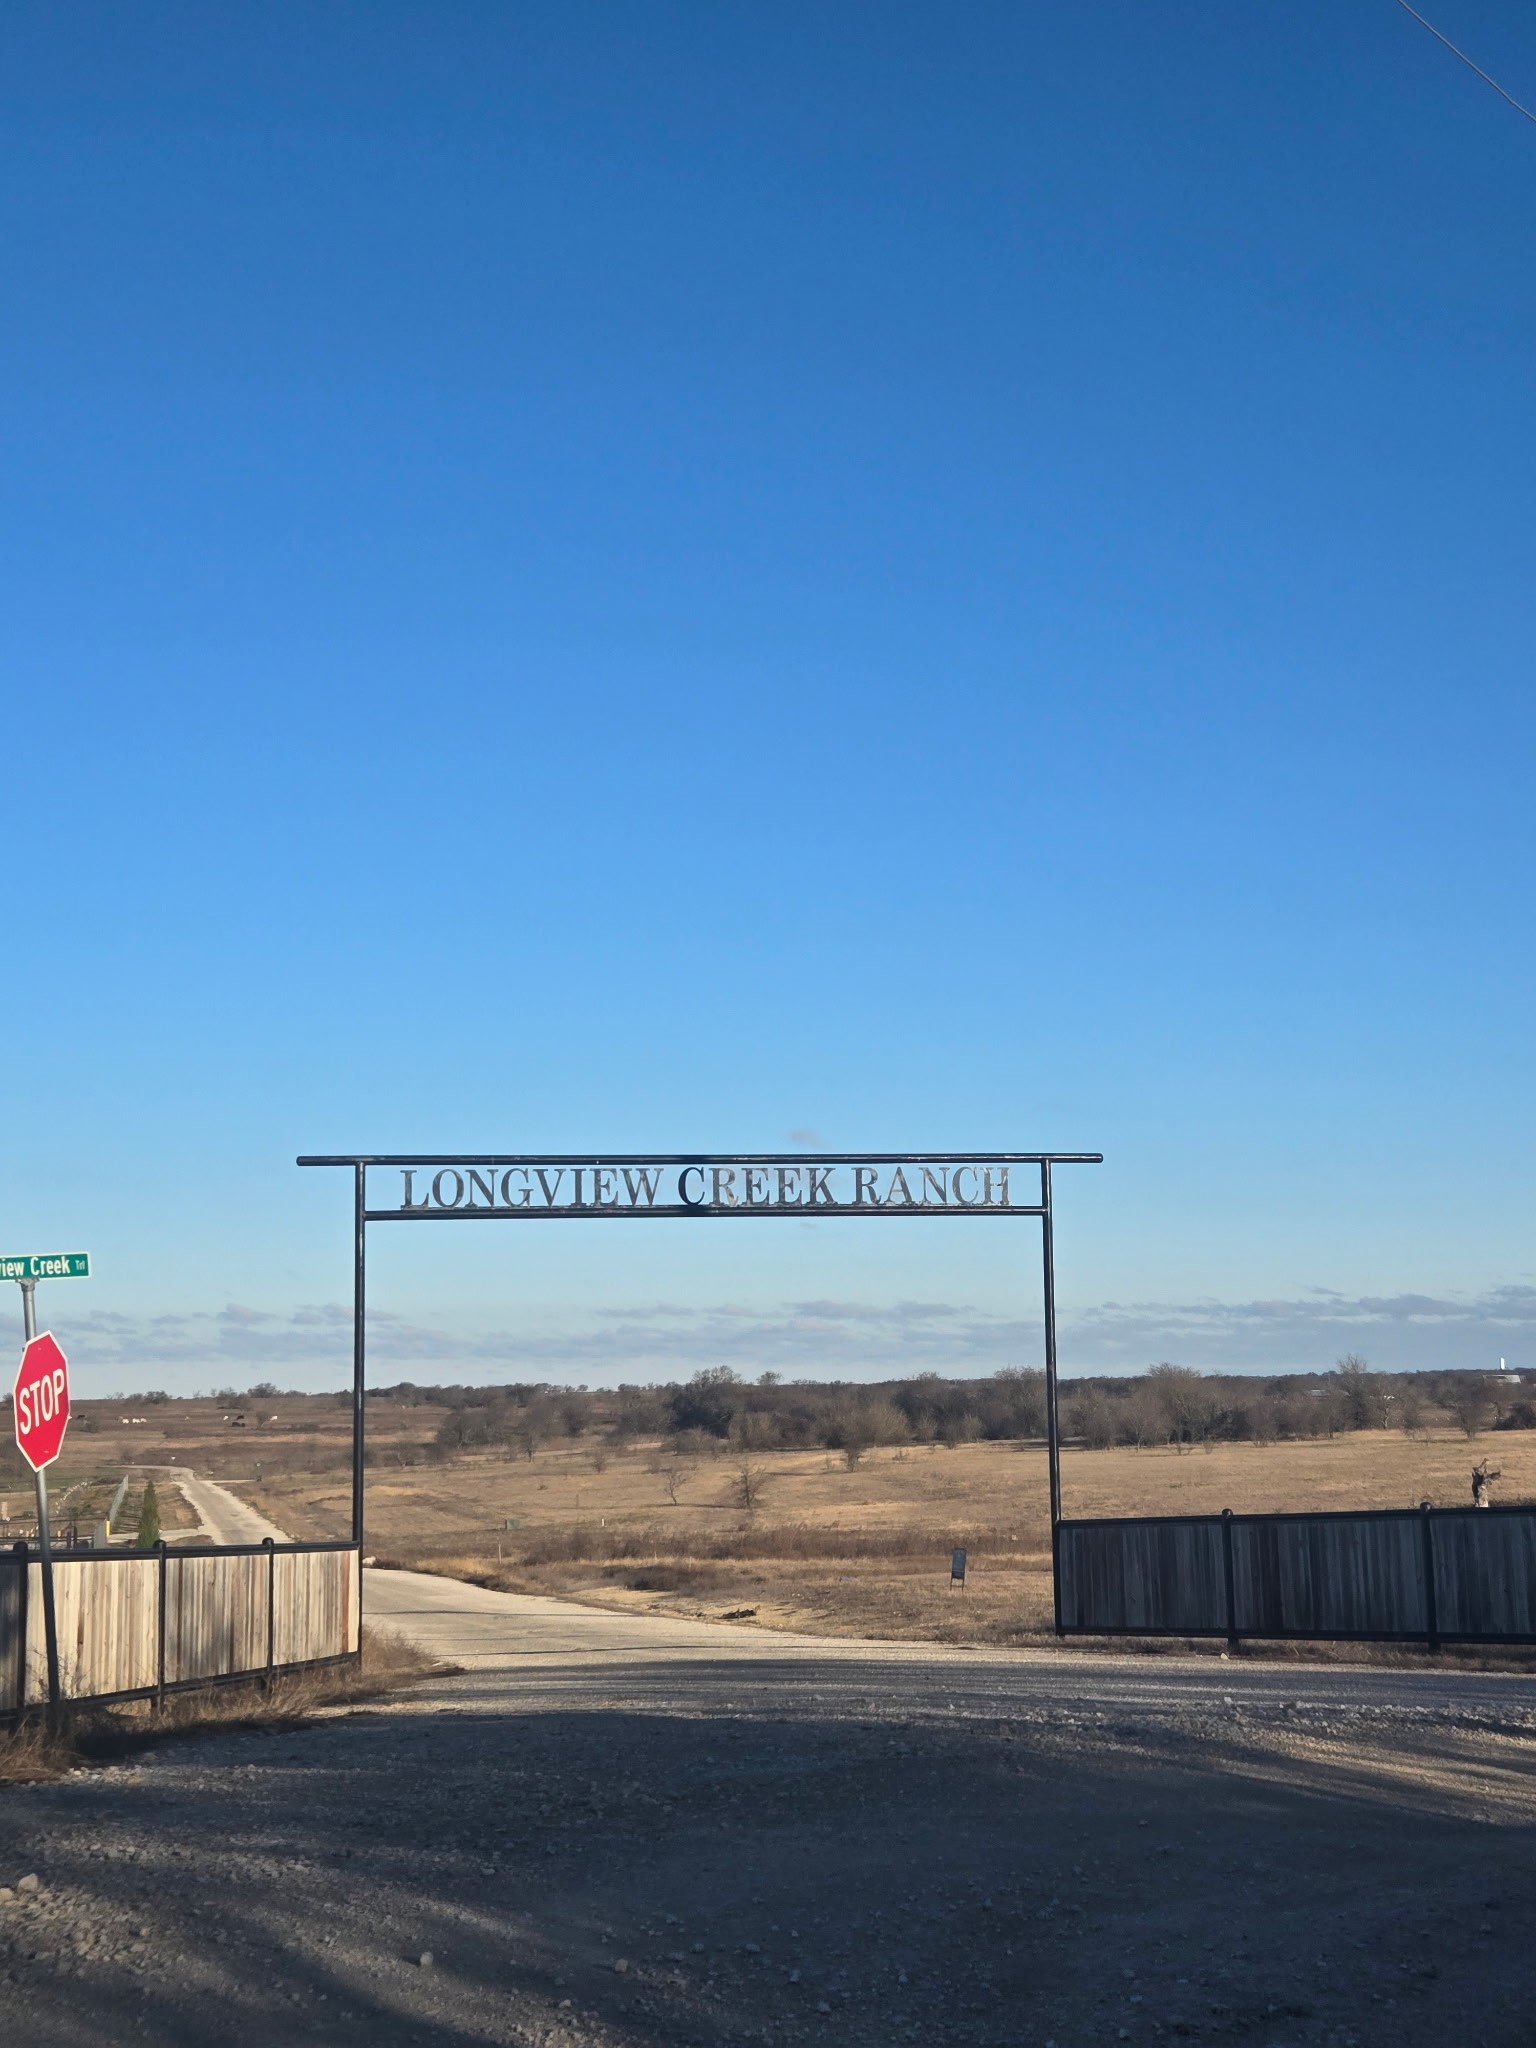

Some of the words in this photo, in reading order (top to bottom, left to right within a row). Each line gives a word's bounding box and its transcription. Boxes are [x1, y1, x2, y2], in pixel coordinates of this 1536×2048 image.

[400, 1167, 664, 1208] LONGVIEW
[678, 1166, 842, 1206] CREEK
[851, 1166, 1012, 1206] RANCH
[0, 1258, 24, 1277] iew
[30, 1256, 71, 1276] Creek
[19, 1368, 65, 1435] STOP
